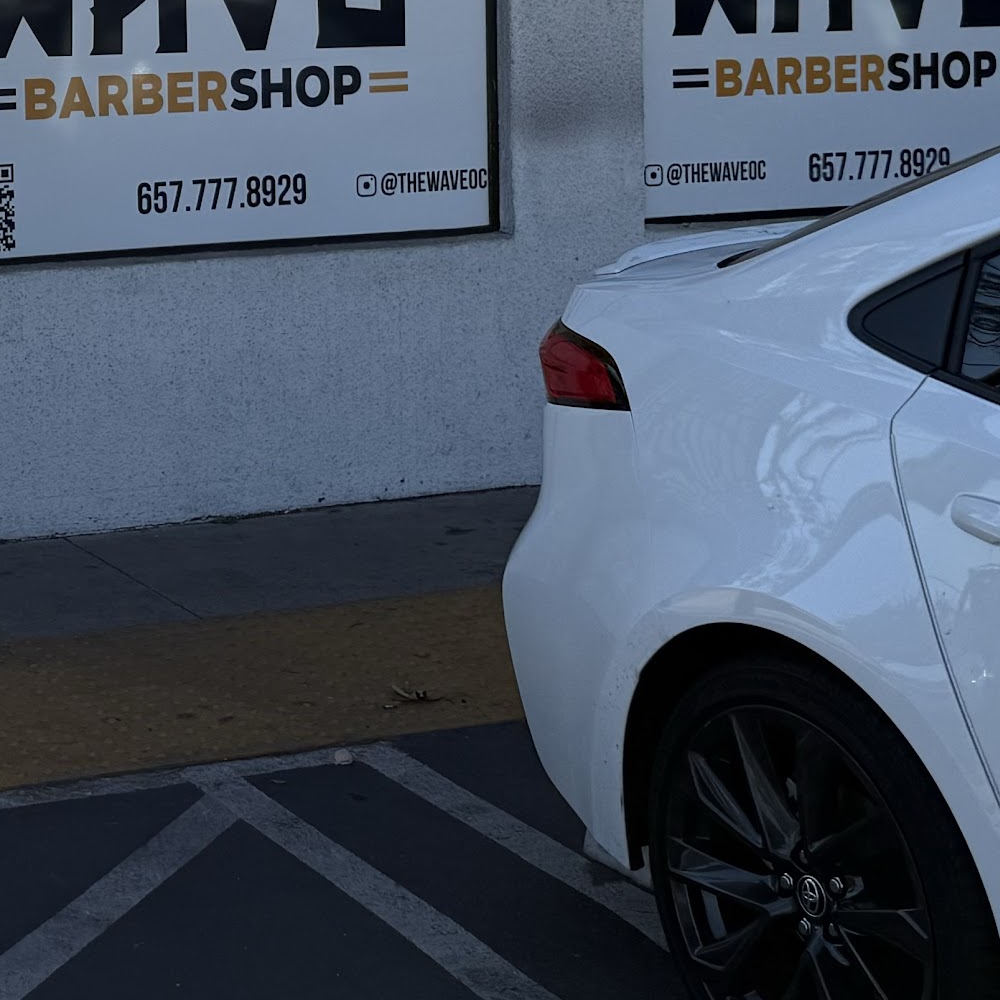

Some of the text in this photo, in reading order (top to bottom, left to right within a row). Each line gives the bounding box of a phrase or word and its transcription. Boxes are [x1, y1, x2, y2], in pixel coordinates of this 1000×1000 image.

[24, 65, 362, 120] BARBERSHOP
[714, 50, 997, 98] BARBERSHOP
[667, 147, 950, 186] @THEWAVEOC 657.777.8929
[137, 168, 487, 215] 657.777.8929 @THEWAVEOC
